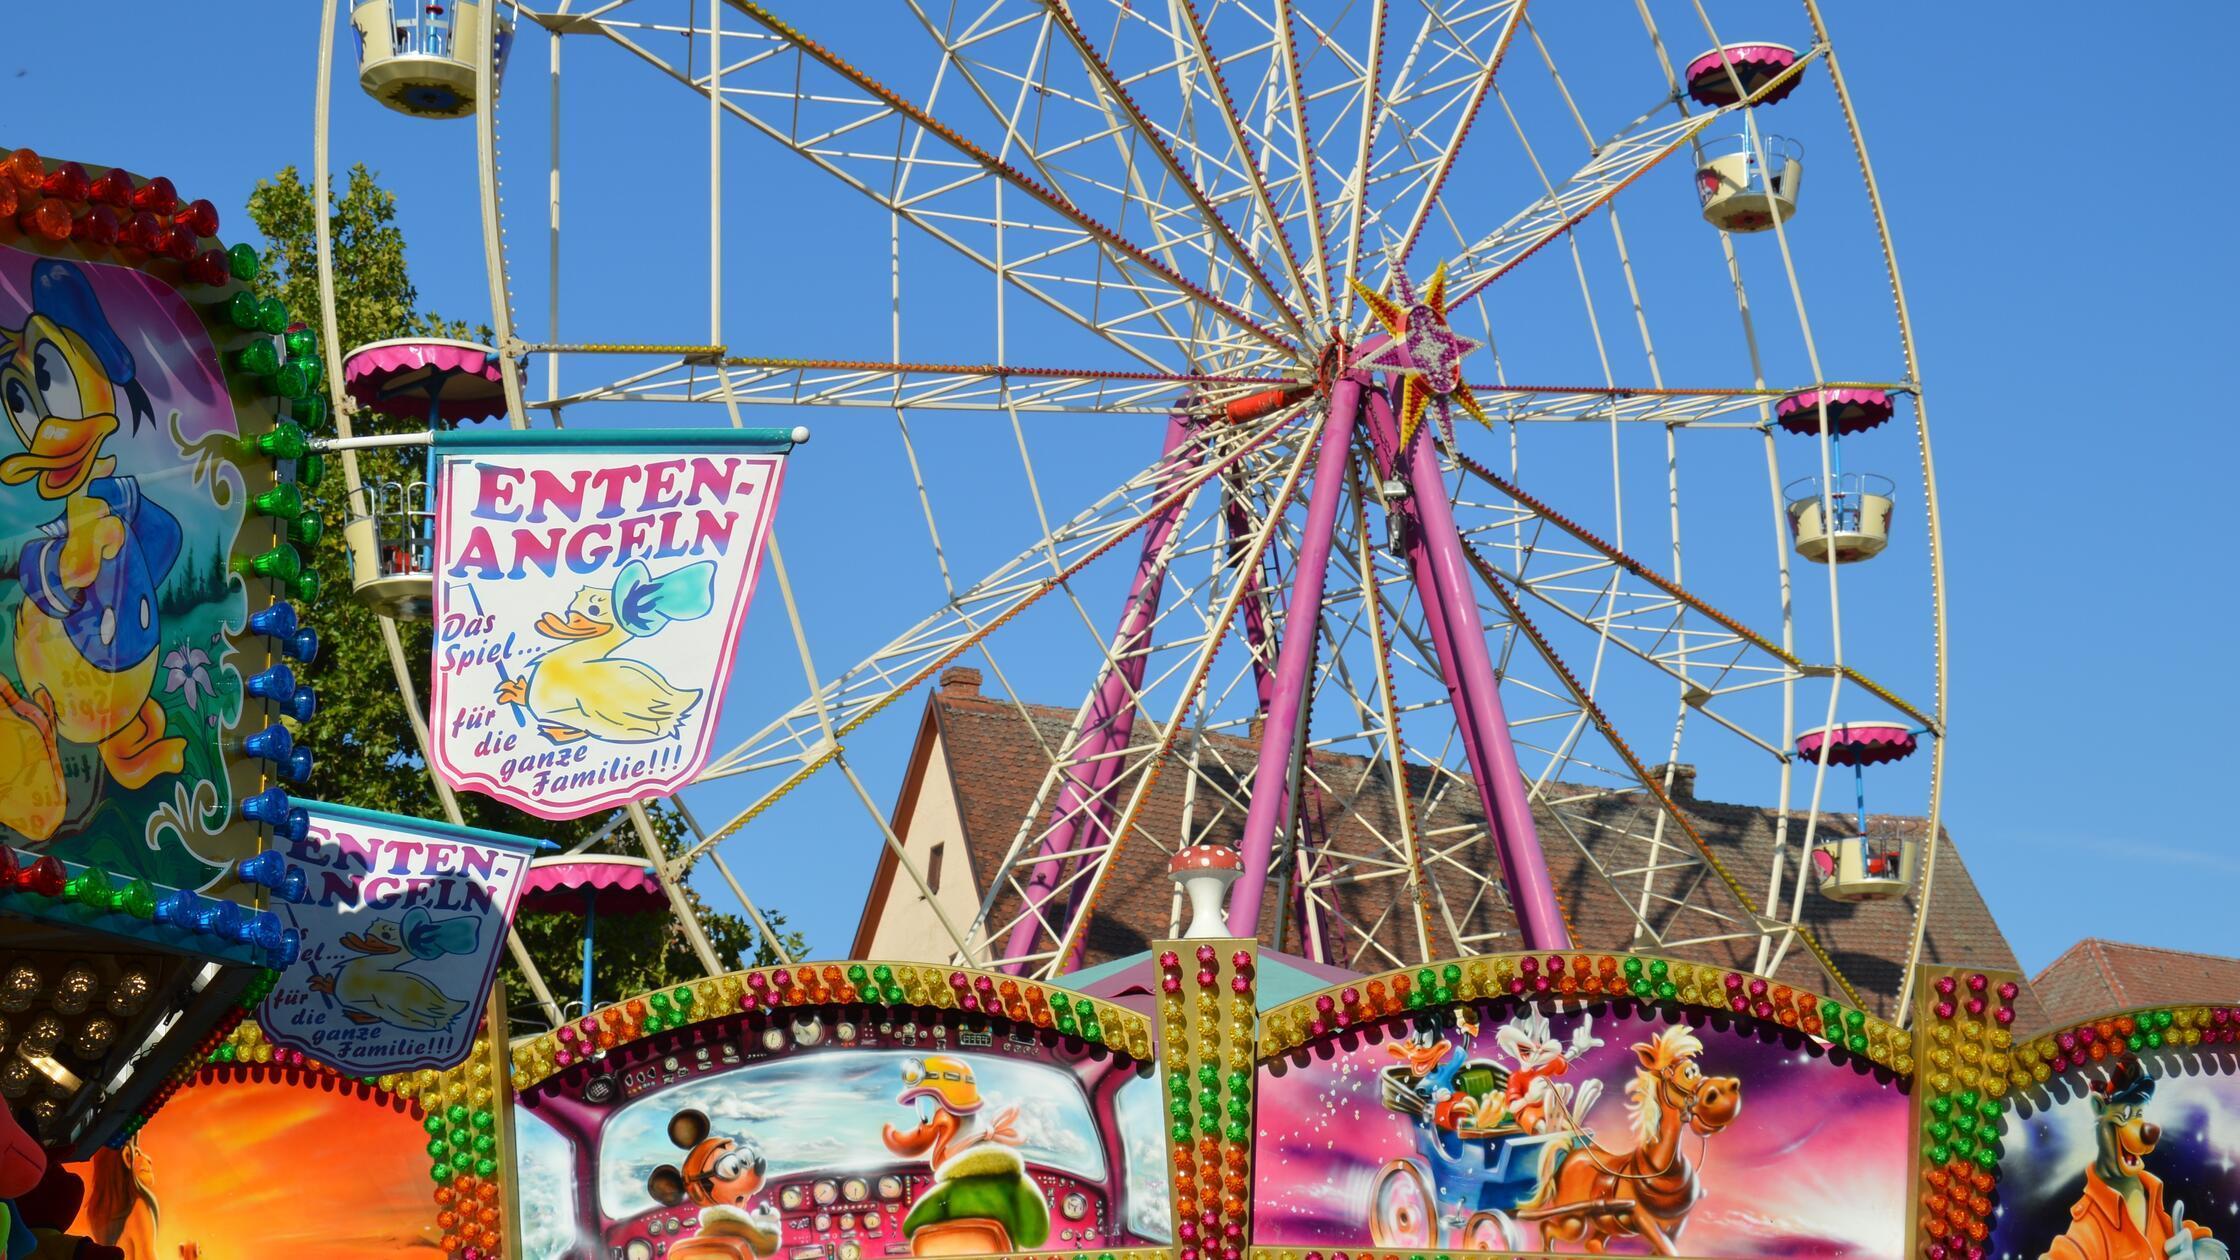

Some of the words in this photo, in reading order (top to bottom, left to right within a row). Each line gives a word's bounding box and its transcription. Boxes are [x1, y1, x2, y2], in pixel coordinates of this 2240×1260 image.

[470, 457, 754, 523] ENTEN-
[448, 510, 739, 580] ANGELN
[441, 612, 495, 642] Das
[440, 632, 542, 676] Spiel...
[452, 706, 495, 739] für
[474, 731, 517, 758] die
[500, 744, 588, 782] ganze
[532, 745, 682, 798] Familie!!!
[287, 827, 508, 879] ENTEN-
[274, 989, 309, 1009] für
[291, 1004, 326, 1025] die
[312, 1027, 382, 1046] ganze
[337, 1037, 454, 1059] Familie!!!
